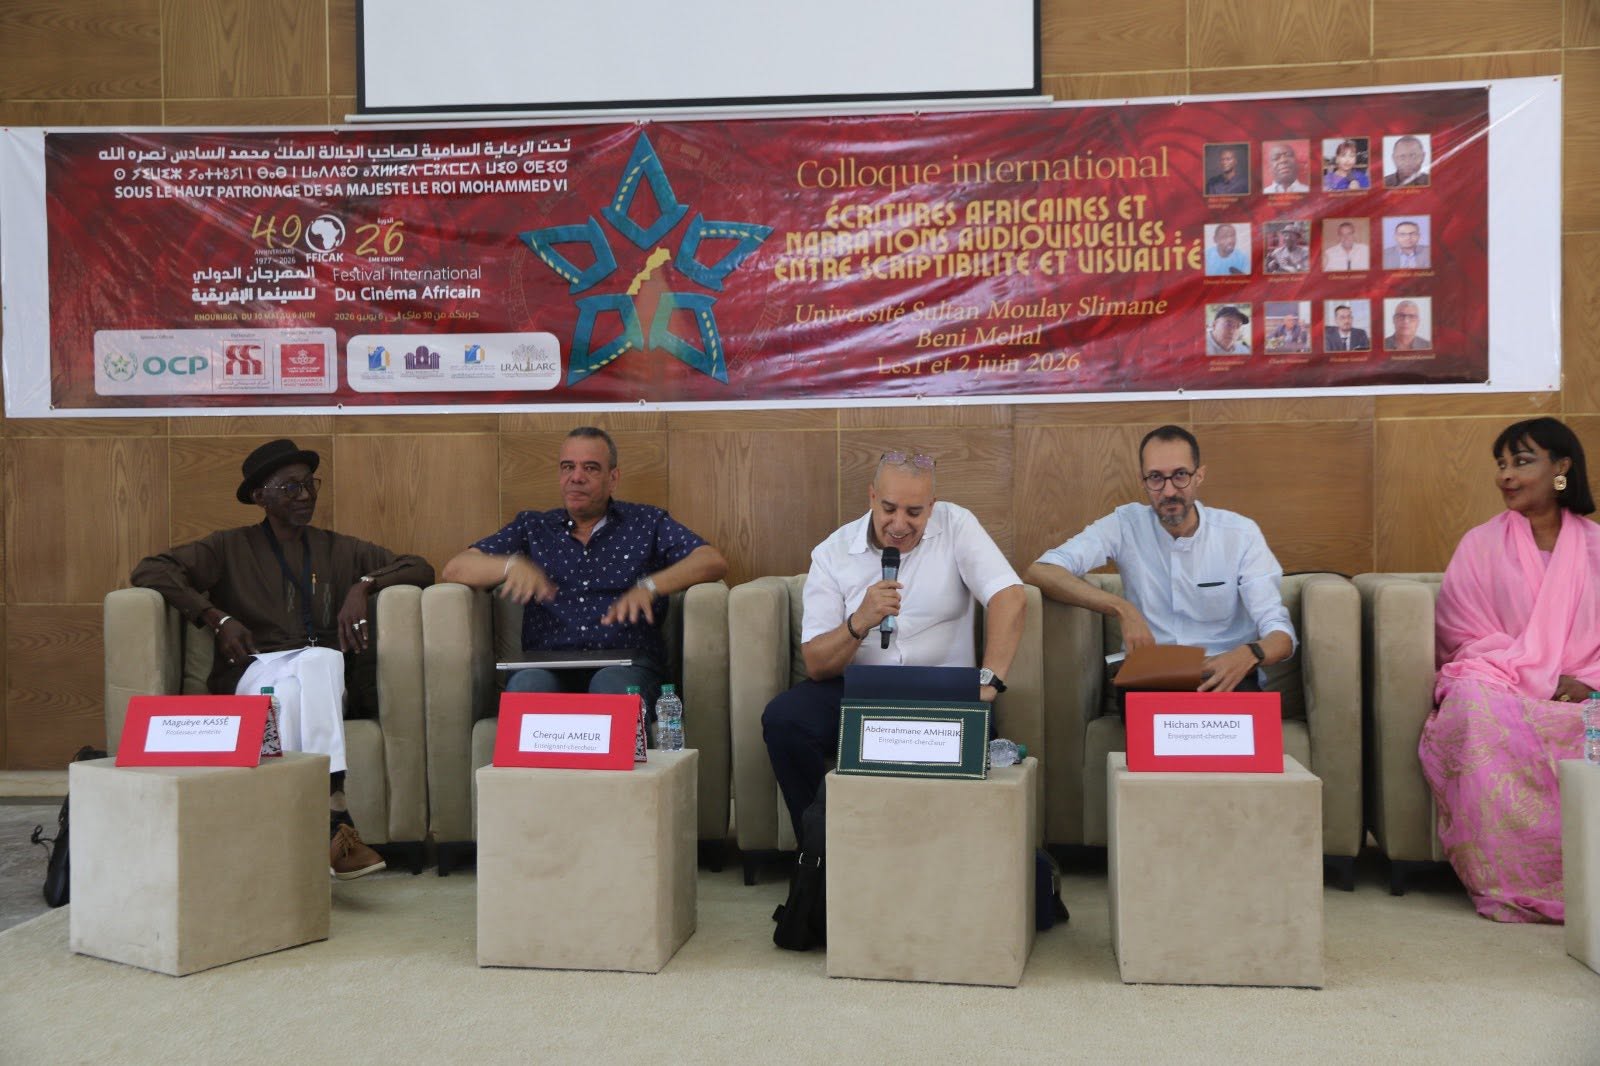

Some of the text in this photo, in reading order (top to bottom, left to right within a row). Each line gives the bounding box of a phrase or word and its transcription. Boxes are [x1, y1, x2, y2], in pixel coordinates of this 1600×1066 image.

[99, 139, 571, 164] تحت الرعاية السامية لصاحب الجلالة الملك محمد السادس نصره الله
[796, 146, 1170, 194] Colloque international
[114, 179, 568, 199] SOUS LE HAUT PATRONAGE DE SA MAJESTE LE ROI MOHAMMED VI
[825, 195, 1148, 229] ÉCRITURES AFRICAINES ET
[250, 214, 302, 249] 49
[355, 220, 405, 256] 26
[785, 228, 950, 256] NARRATIONS
[255, 256, 272, 265] 1977
[279, 256, 296, 265] 2026
[774, 256, 852, 282] ENTRE
[860, 247, 1030, 281] SCRIPTIBILITÉ
[1039, 250, 1069, 275] ET
[193, 266, 316, 284] المهرجان الدولي
[333, 265, 481, 282] Festival International
[192, 287, 316, 305] للسينما الإفريقية
[335, 285, 481, 301] Du Cinéma Africain
[795, 296, 1169, 324] Université Sultan Moulay Slimane
[915, 325, 1042, 349] Beni Mellal
[142, 355, 209, 376] OCP
[877, 357, 911, 374] Les
[930, 356, 952, 375] et
[957, 355, 970, 374] 2
[974, 354, 1019, 380] juin
[1028, 351, 1081, 373] 2026
[203, 716, 230, 726] KASSÉ
[865, 726, 922, 736] Abderrahmane
[1164, 720, 1241, 729] Hicham SAMADI
[532, 731, 601, 741] Cherqui AMEUR
[1168, 733, 1237, 741] Enseignant-chercheur
